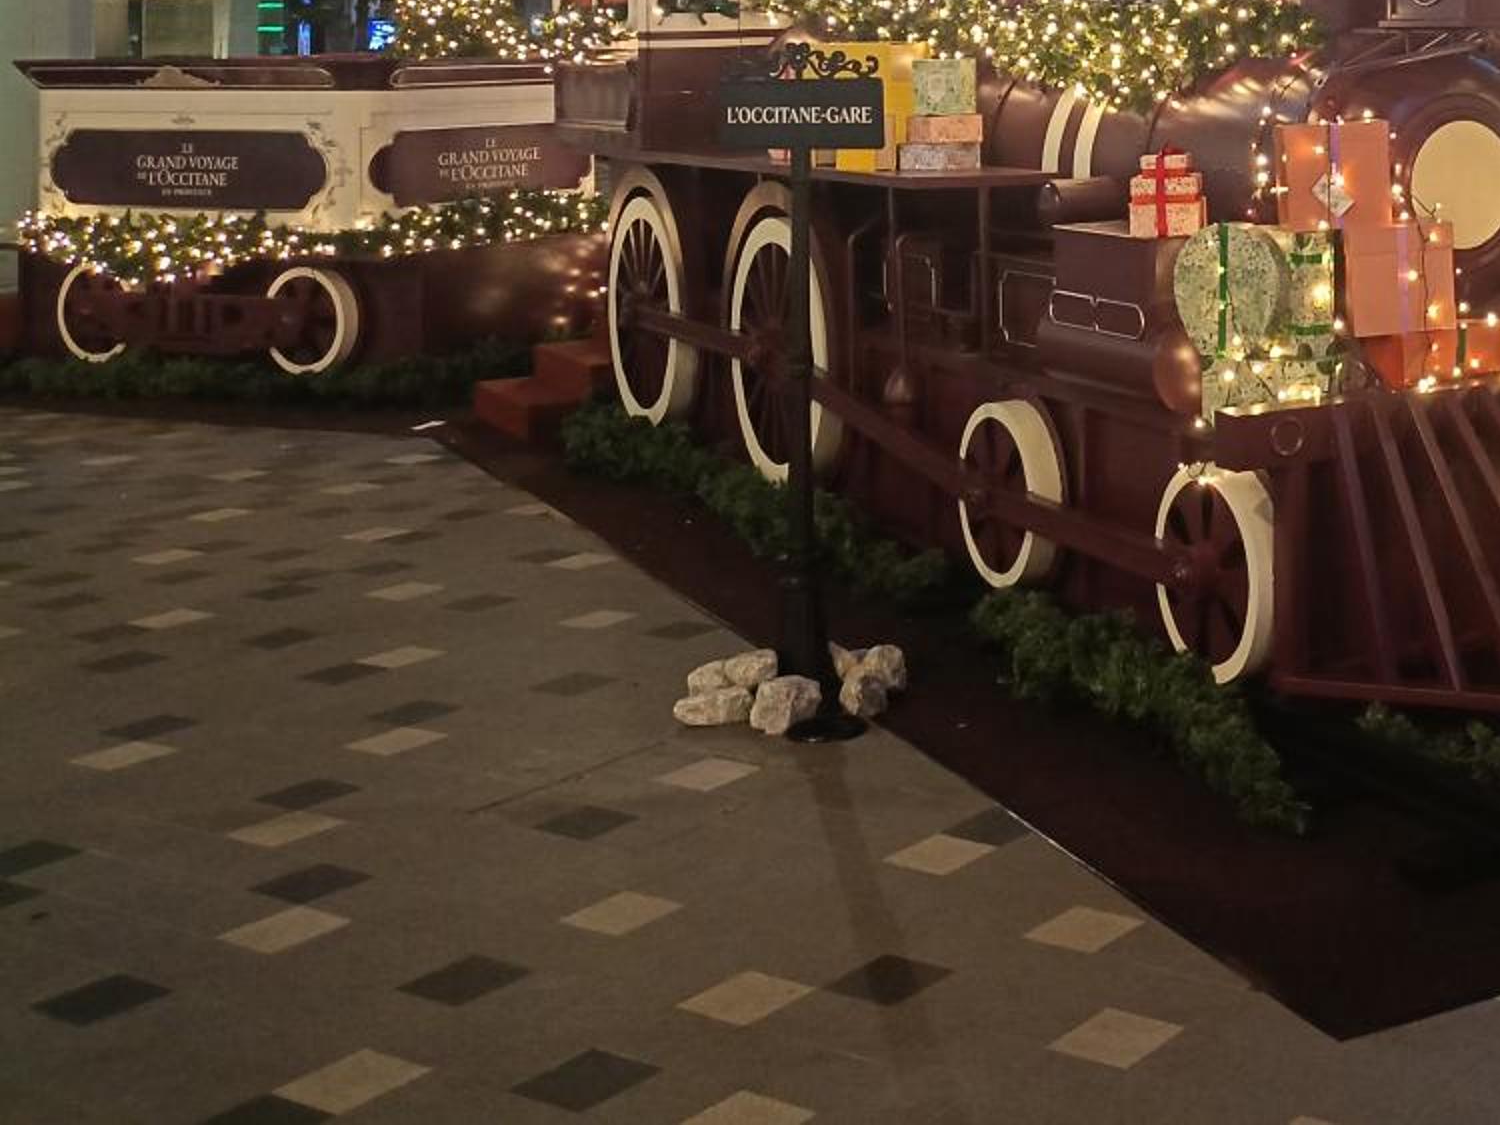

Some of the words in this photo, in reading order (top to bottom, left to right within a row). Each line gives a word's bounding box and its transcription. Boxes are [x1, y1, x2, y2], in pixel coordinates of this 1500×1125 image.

[137, 155, 187, 170] GRAND
[189, 156, 239, 170] VOYAGE
[437, 149, 489, 166] GRAND
[491, 146, 541, 162] VOYAGE
[149, 168, 228, 186] L'OCCITANE
[451, 163, 529, 182] L'OCCITANE
